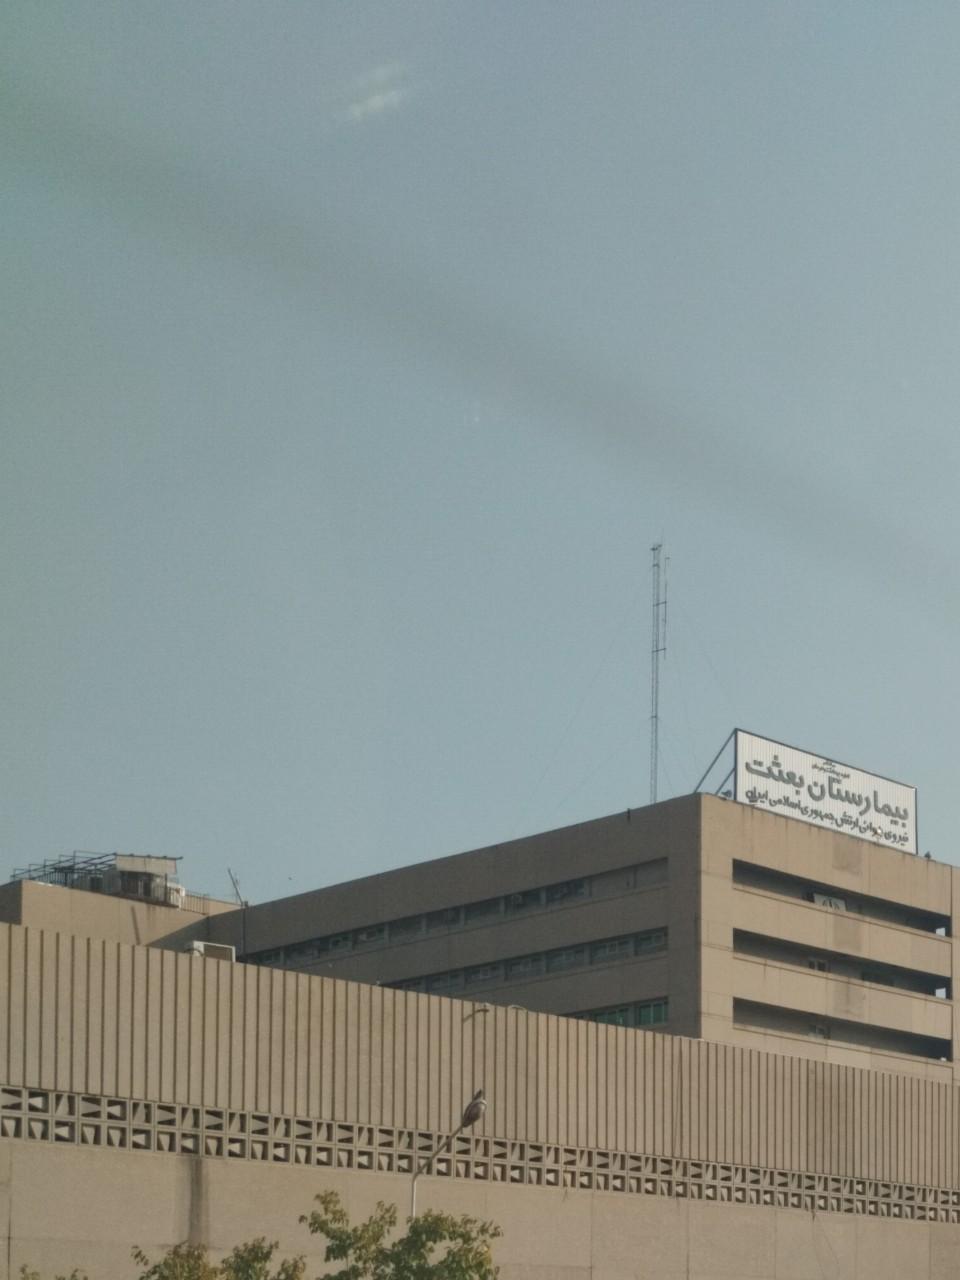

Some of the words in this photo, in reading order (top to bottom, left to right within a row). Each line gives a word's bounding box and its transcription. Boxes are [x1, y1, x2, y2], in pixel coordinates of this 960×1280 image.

[745, 754, 805, 795] بعثت
[769, 795, 801, 810] اسلامی
[807, 775, 909, 828] بیمارستان
[801, 806, 835, 825] جمهوری
[835, 811, 859, 830] ارتش
[884, 831, 909, 846] نیروی
